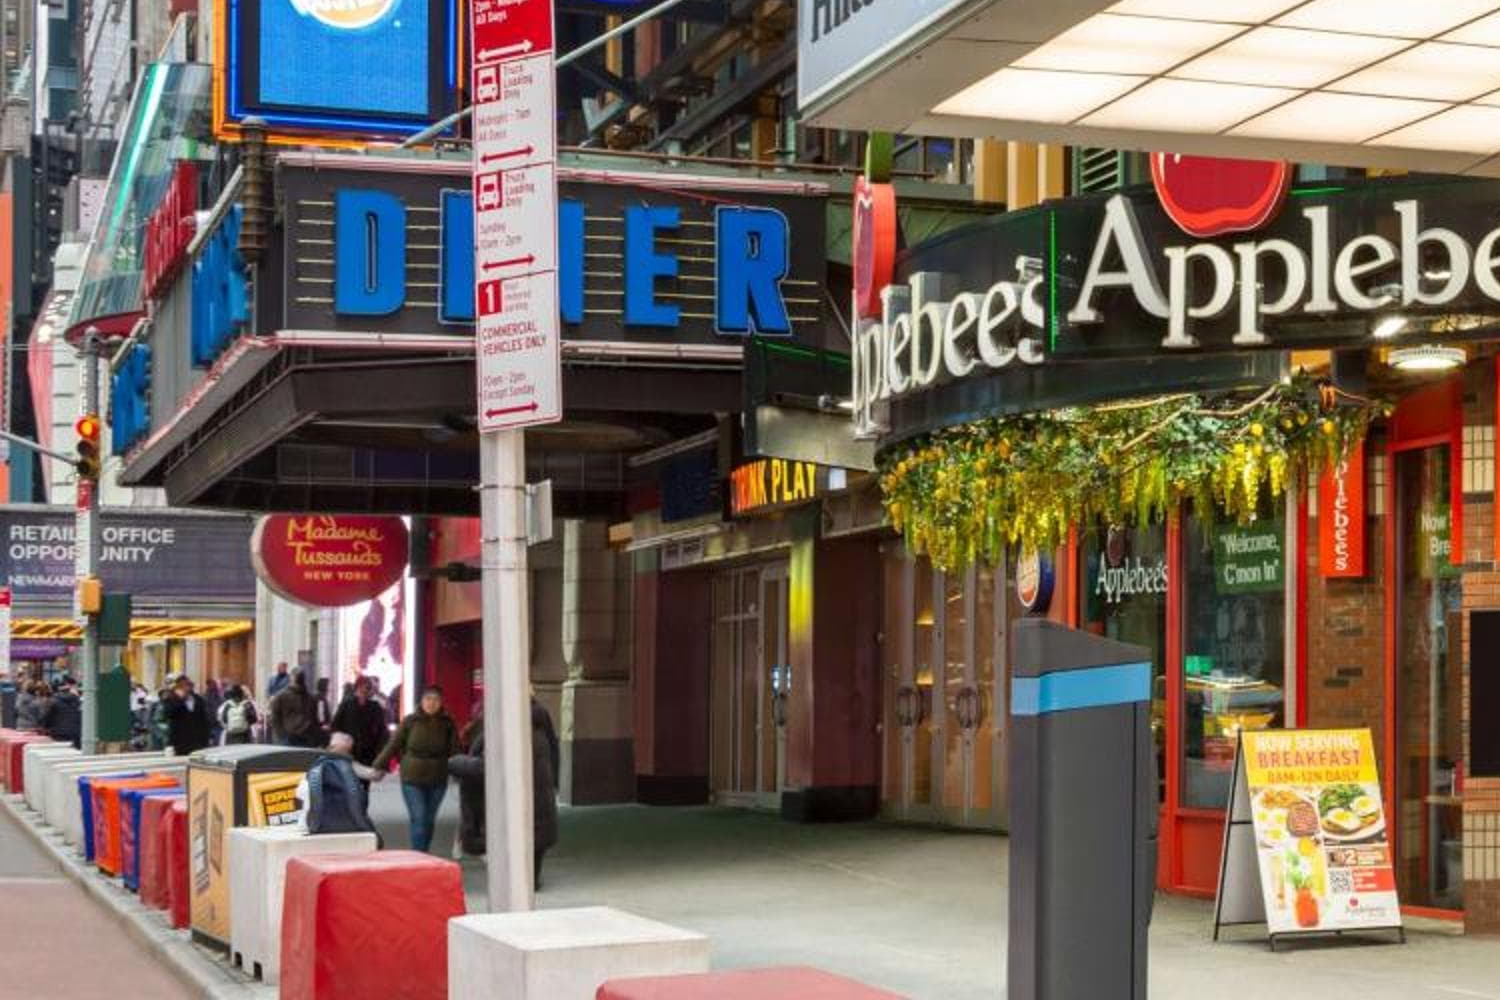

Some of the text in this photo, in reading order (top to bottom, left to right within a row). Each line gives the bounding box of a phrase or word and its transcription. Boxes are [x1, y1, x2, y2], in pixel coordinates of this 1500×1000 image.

[486, 283, 495, 313] 1
[481, 320, 537, 340] COMMERCIAL
[483, 334, 547, 356] VEHICLES ONLY
[771, 459, 817, 504] PLAY
[102, 527, 176, 544] OFFICE
[287, 514, 384, 541] Madame
[286, 540, 383, 566] Tussauds
[304, 571, 370, 581] NEW YORK
[1258, 749, 1360, 769] BREAKFAST
